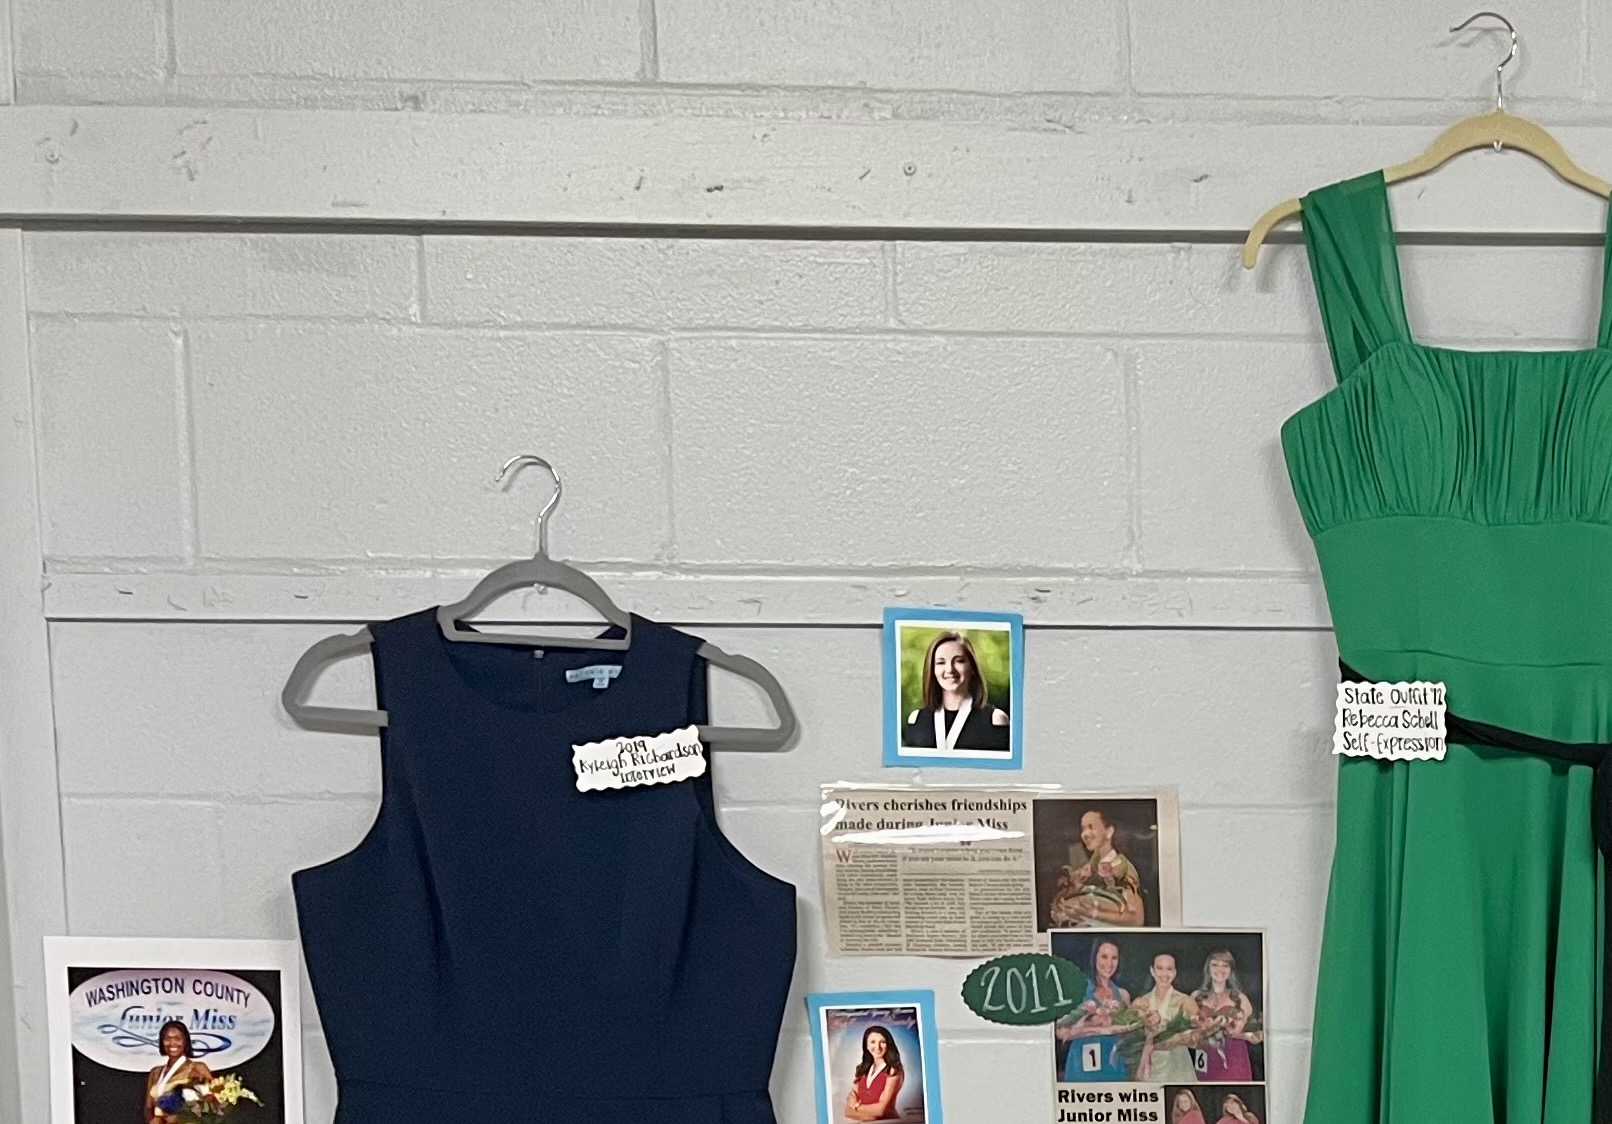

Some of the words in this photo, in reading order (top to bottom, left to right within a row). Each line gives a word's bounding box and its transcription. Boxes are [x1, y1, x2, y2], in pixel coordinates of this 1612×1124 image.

[1344, 687, 1384, 705] State
[1342, 708, 1399, 728] Rebecca
[616, 740, 647, 754] 2019
[580, 753, 627, 776] Kyleigh
[883, 798, 947, 812] cherishes
[951, 798, 1027, 814] friendships
[836, 818, 872, 830] made
[85, 977, 185, 1008] WASHINGTON
[192, 979, 251, 1008] COUNTY
[980, 963, 1072, 1014] 2011
[190, 1008, 237, 1030] Miss
[1088, 1049, 1097, 1068] 1
[1197, 1051, 1205, 1069] 6
[1058, 1089, 1114, 1104] Rivers
[1118, 1089, 1159, 1103] wins
[1057, 1108, 1112, 1123] Junior
[1117, 1108, 1159, 1122] Miss
